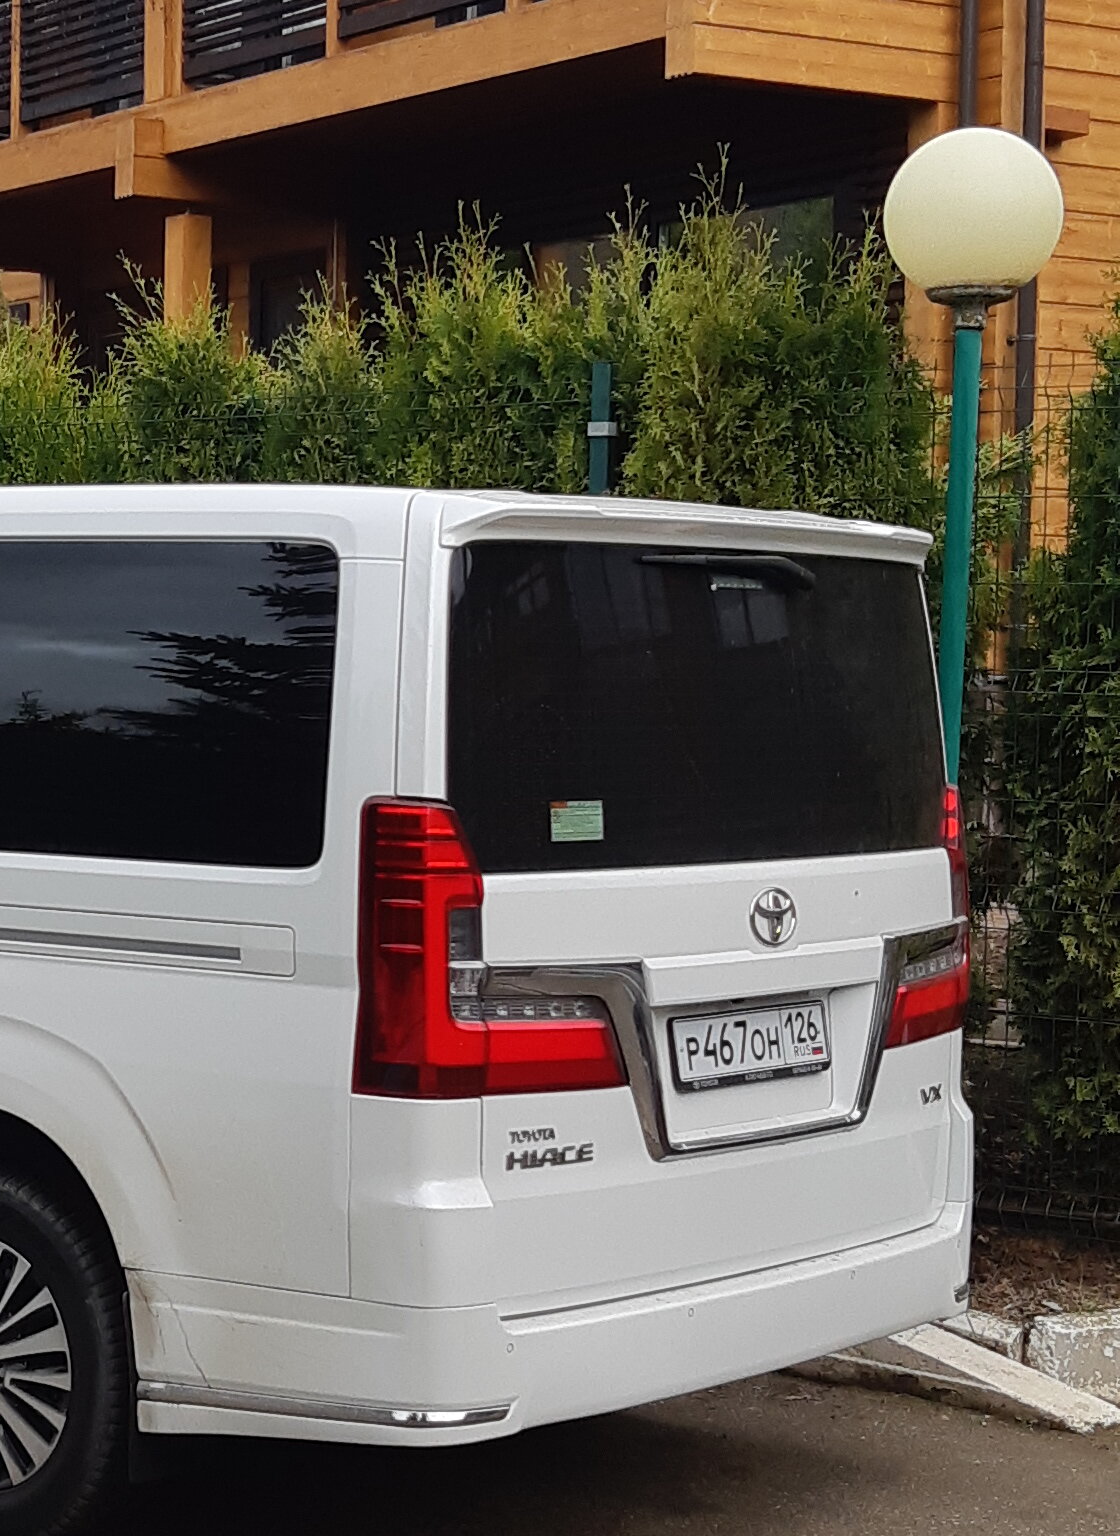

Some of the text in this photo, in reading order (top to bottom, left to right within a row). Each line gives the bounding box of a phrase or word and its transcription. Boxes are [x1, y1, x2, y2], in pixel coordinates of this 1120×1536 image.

[784, 1010, 818, 1044] 126
[794, 1045, 812, 1058] RUS
[920, 1083, 942, 1105] VX
[509, 1128, 556, 1144] TOYOTA
[505, 1143, 594, 1171] HIACE
